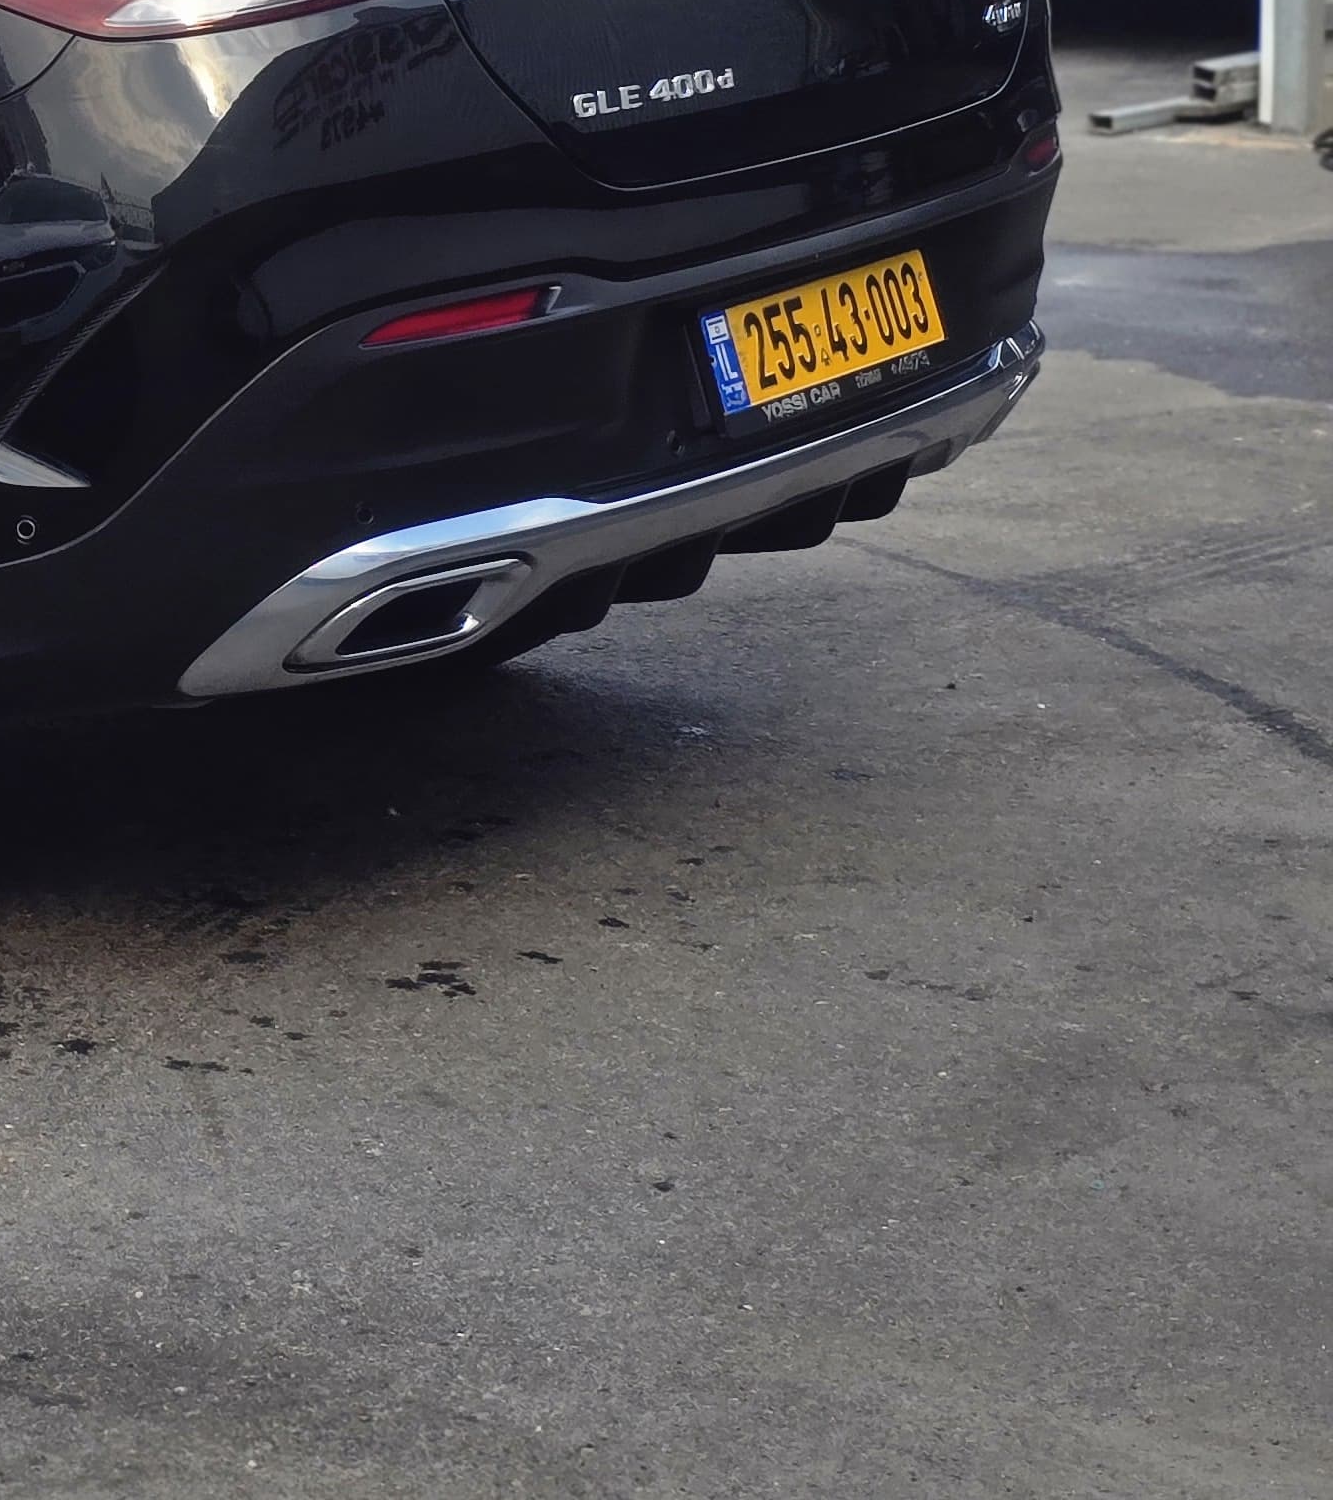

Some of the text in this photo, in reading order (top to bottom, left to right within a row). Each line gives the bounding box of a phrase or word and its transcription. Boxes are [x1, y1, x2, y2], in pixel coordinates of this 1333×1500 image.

[572, 84, 644, 118] GLE
[761, 391, 808, 422] YOSSI
[810, 382, 842, 405] CAR
